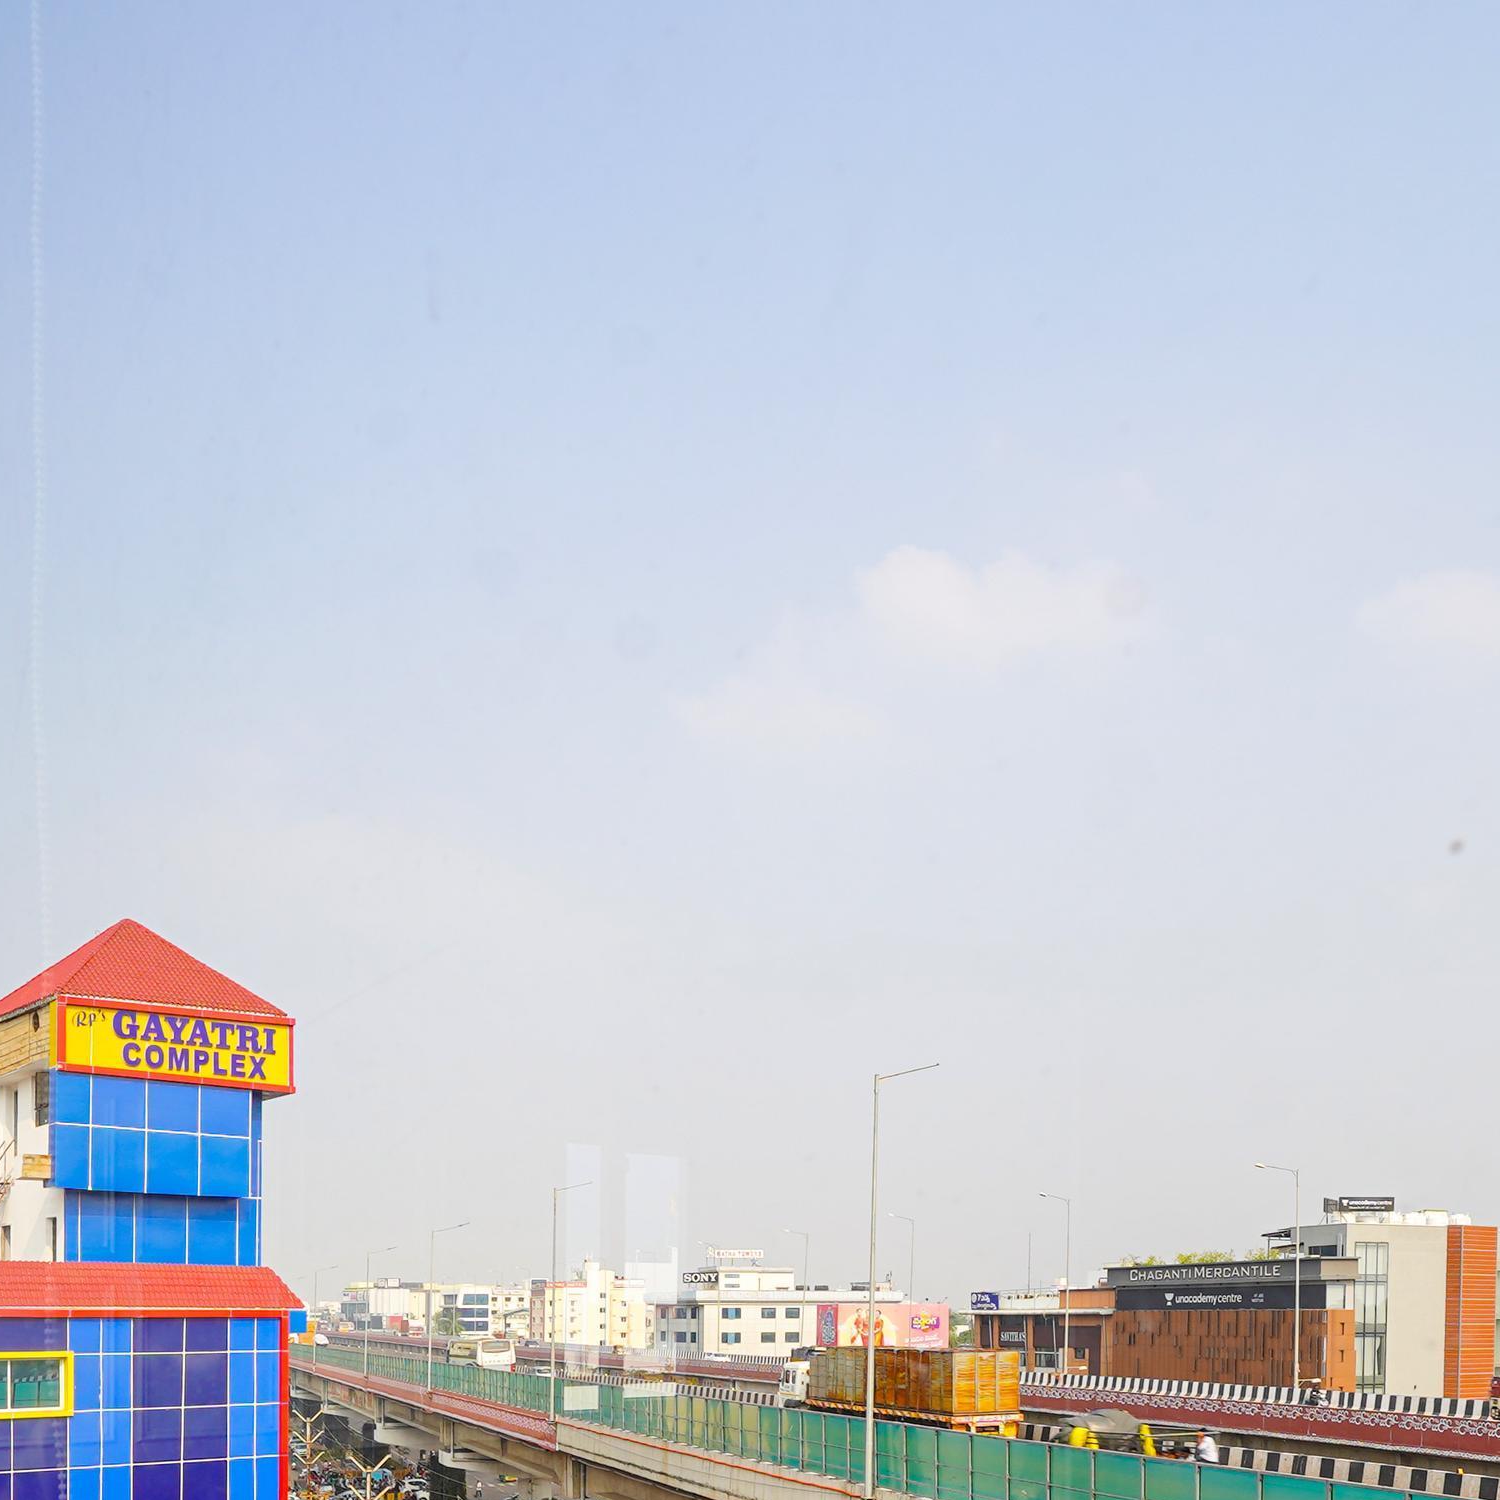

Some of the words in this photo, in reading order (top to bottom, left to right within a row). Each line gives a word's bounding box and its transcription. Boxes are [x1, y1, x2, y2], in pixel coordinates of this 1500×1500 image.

[113, 1009, 276, 1055] GAYATRI
[122, 1042, 266, 1080] COMPLEX
[683, 1273, 718, 1283] SONY
[1129, 1267, 1192, 1281] CHAGANTI
[1193, 1265, 1281, 1279] MERCANTILE
[1174, 1293, 1218, 1306] unacademy
[1218, 1294, 1243, 1303] centre
